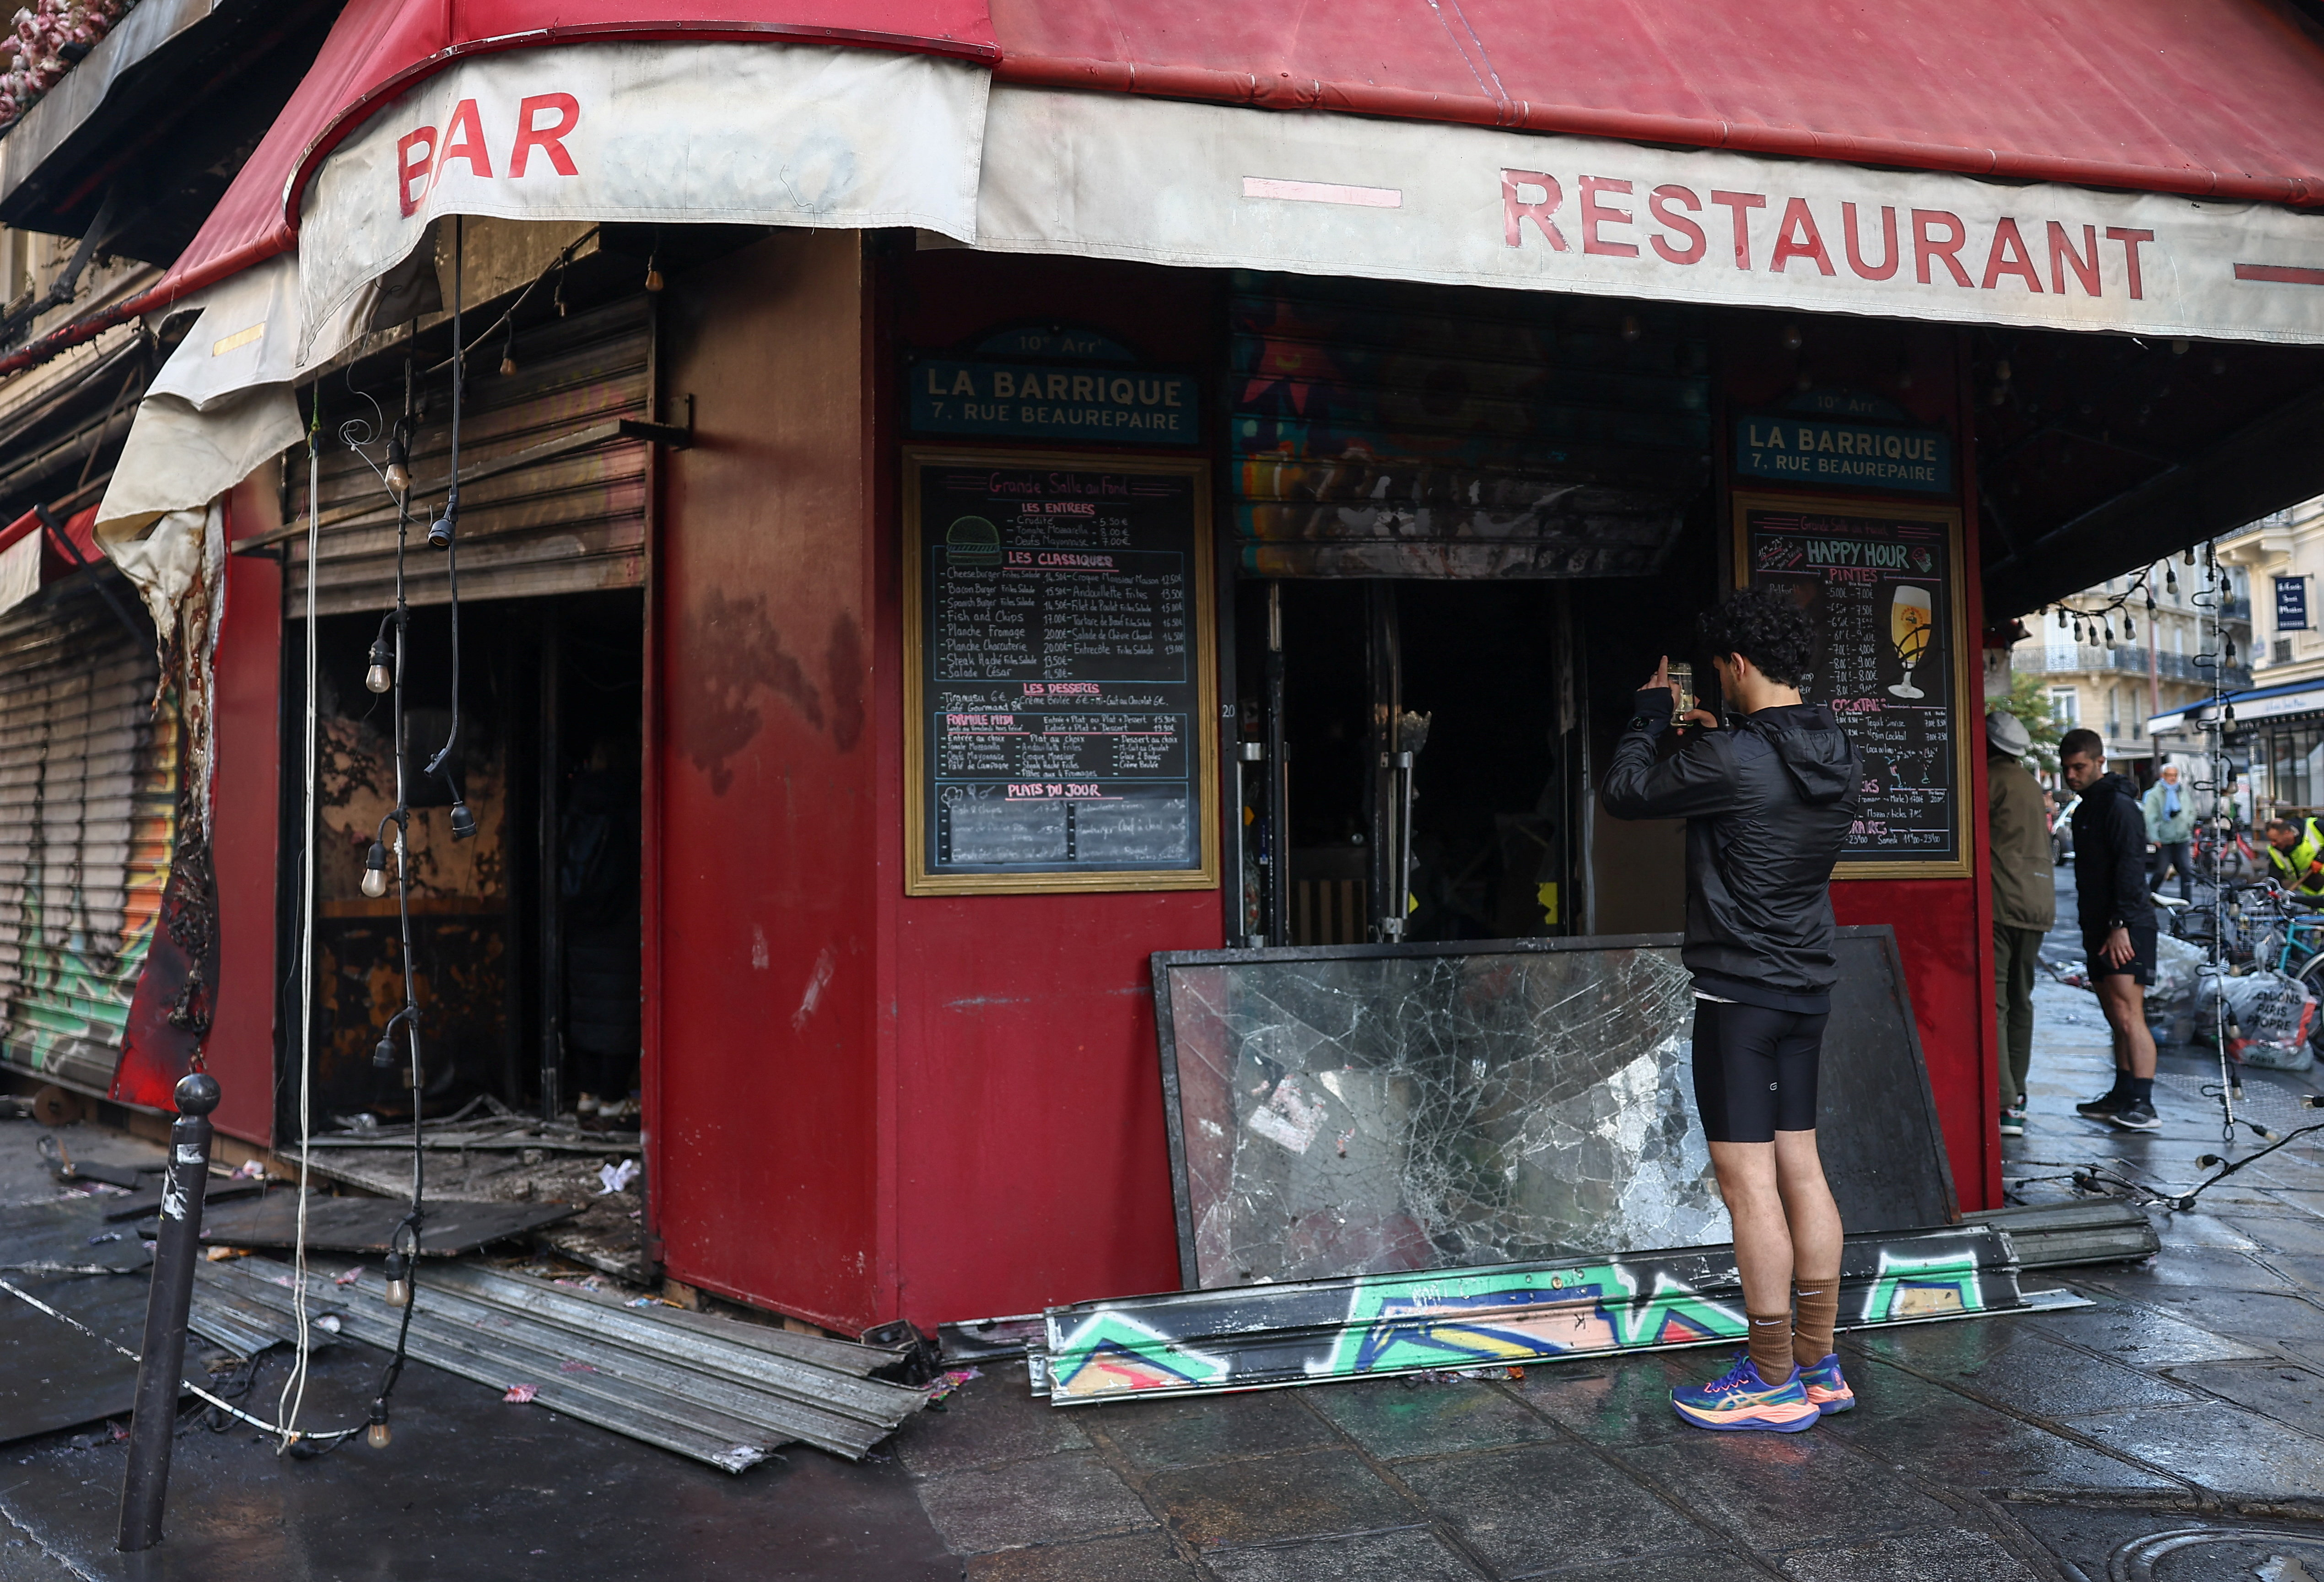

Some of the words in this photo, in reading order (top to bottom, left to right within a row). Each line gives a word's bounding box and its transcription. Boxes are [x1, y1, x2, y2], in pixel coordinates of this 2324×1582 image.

[397, 92, 580, 219] BAR
[1500, 167, 2154, 306] RESTAURANT
[928, 368, 975, 396] LA
[994, 371, 1182, 407] BARRIQUE
[964, 403, 1009, 421] RUE
[1021, 406, 1180, 430] BEAUREPAIRE
[1750, 424, 1785, 449] LA
[1799, 427, 1937, 461] BARRIQUE
[1752, 453, 1769, 470] 7,
[1776, 454, 1811, 472] RUE
[1818, 458, 1936, 481] BEAUREPAIRE
[989, 472, 1042, 494] Grande
[1049, 472, 1082, 494] Salle
[1085, 483, 1100, 495] au
[1101, 475, 1129, 495] Fond
[1021, 502, 1041, 513] LES
[1008, 551, 1033, 565] LES
[1038, 552, 1114, 568] CLASSIQUES
[1806, 540, 1862, 565] HAPPY
[1864, 542, 1910, 569] HOUR
[947, 566, 1001, 582] Cheeseburger
[1072, 571, 1100, 584] Croque
[1829, 568, 1878, 583] PINTES
[946, 610, 970, 622] Fish
[973, 610, 991, 622] and
[995, 610, 1024, 624] Chips
[946, 623, 981, 637] Planche
[988, 624, 1025, 639] Fromage
[945, 637, 981, 652] Planche
[946, 652, 975, 667] Steak
[947, 665, 978, 679] Salade
[986, 664, 1013, 678] César
[1023, 682, 1045, 695] LES
[1046, 682, 1100, 695] DESSERTS
[967, 702, 1009, 713] Gourmand
[1222, 704, 1235, 718] 20
[946, 713, 989, 725] FORMULE
[990, 714, 1014, 725] MIDI
[1007, 783, 1044, 797] PLATS
[1045, 783, 1063, 798] DU
[1064, 783, 1102, 798] JOUR
